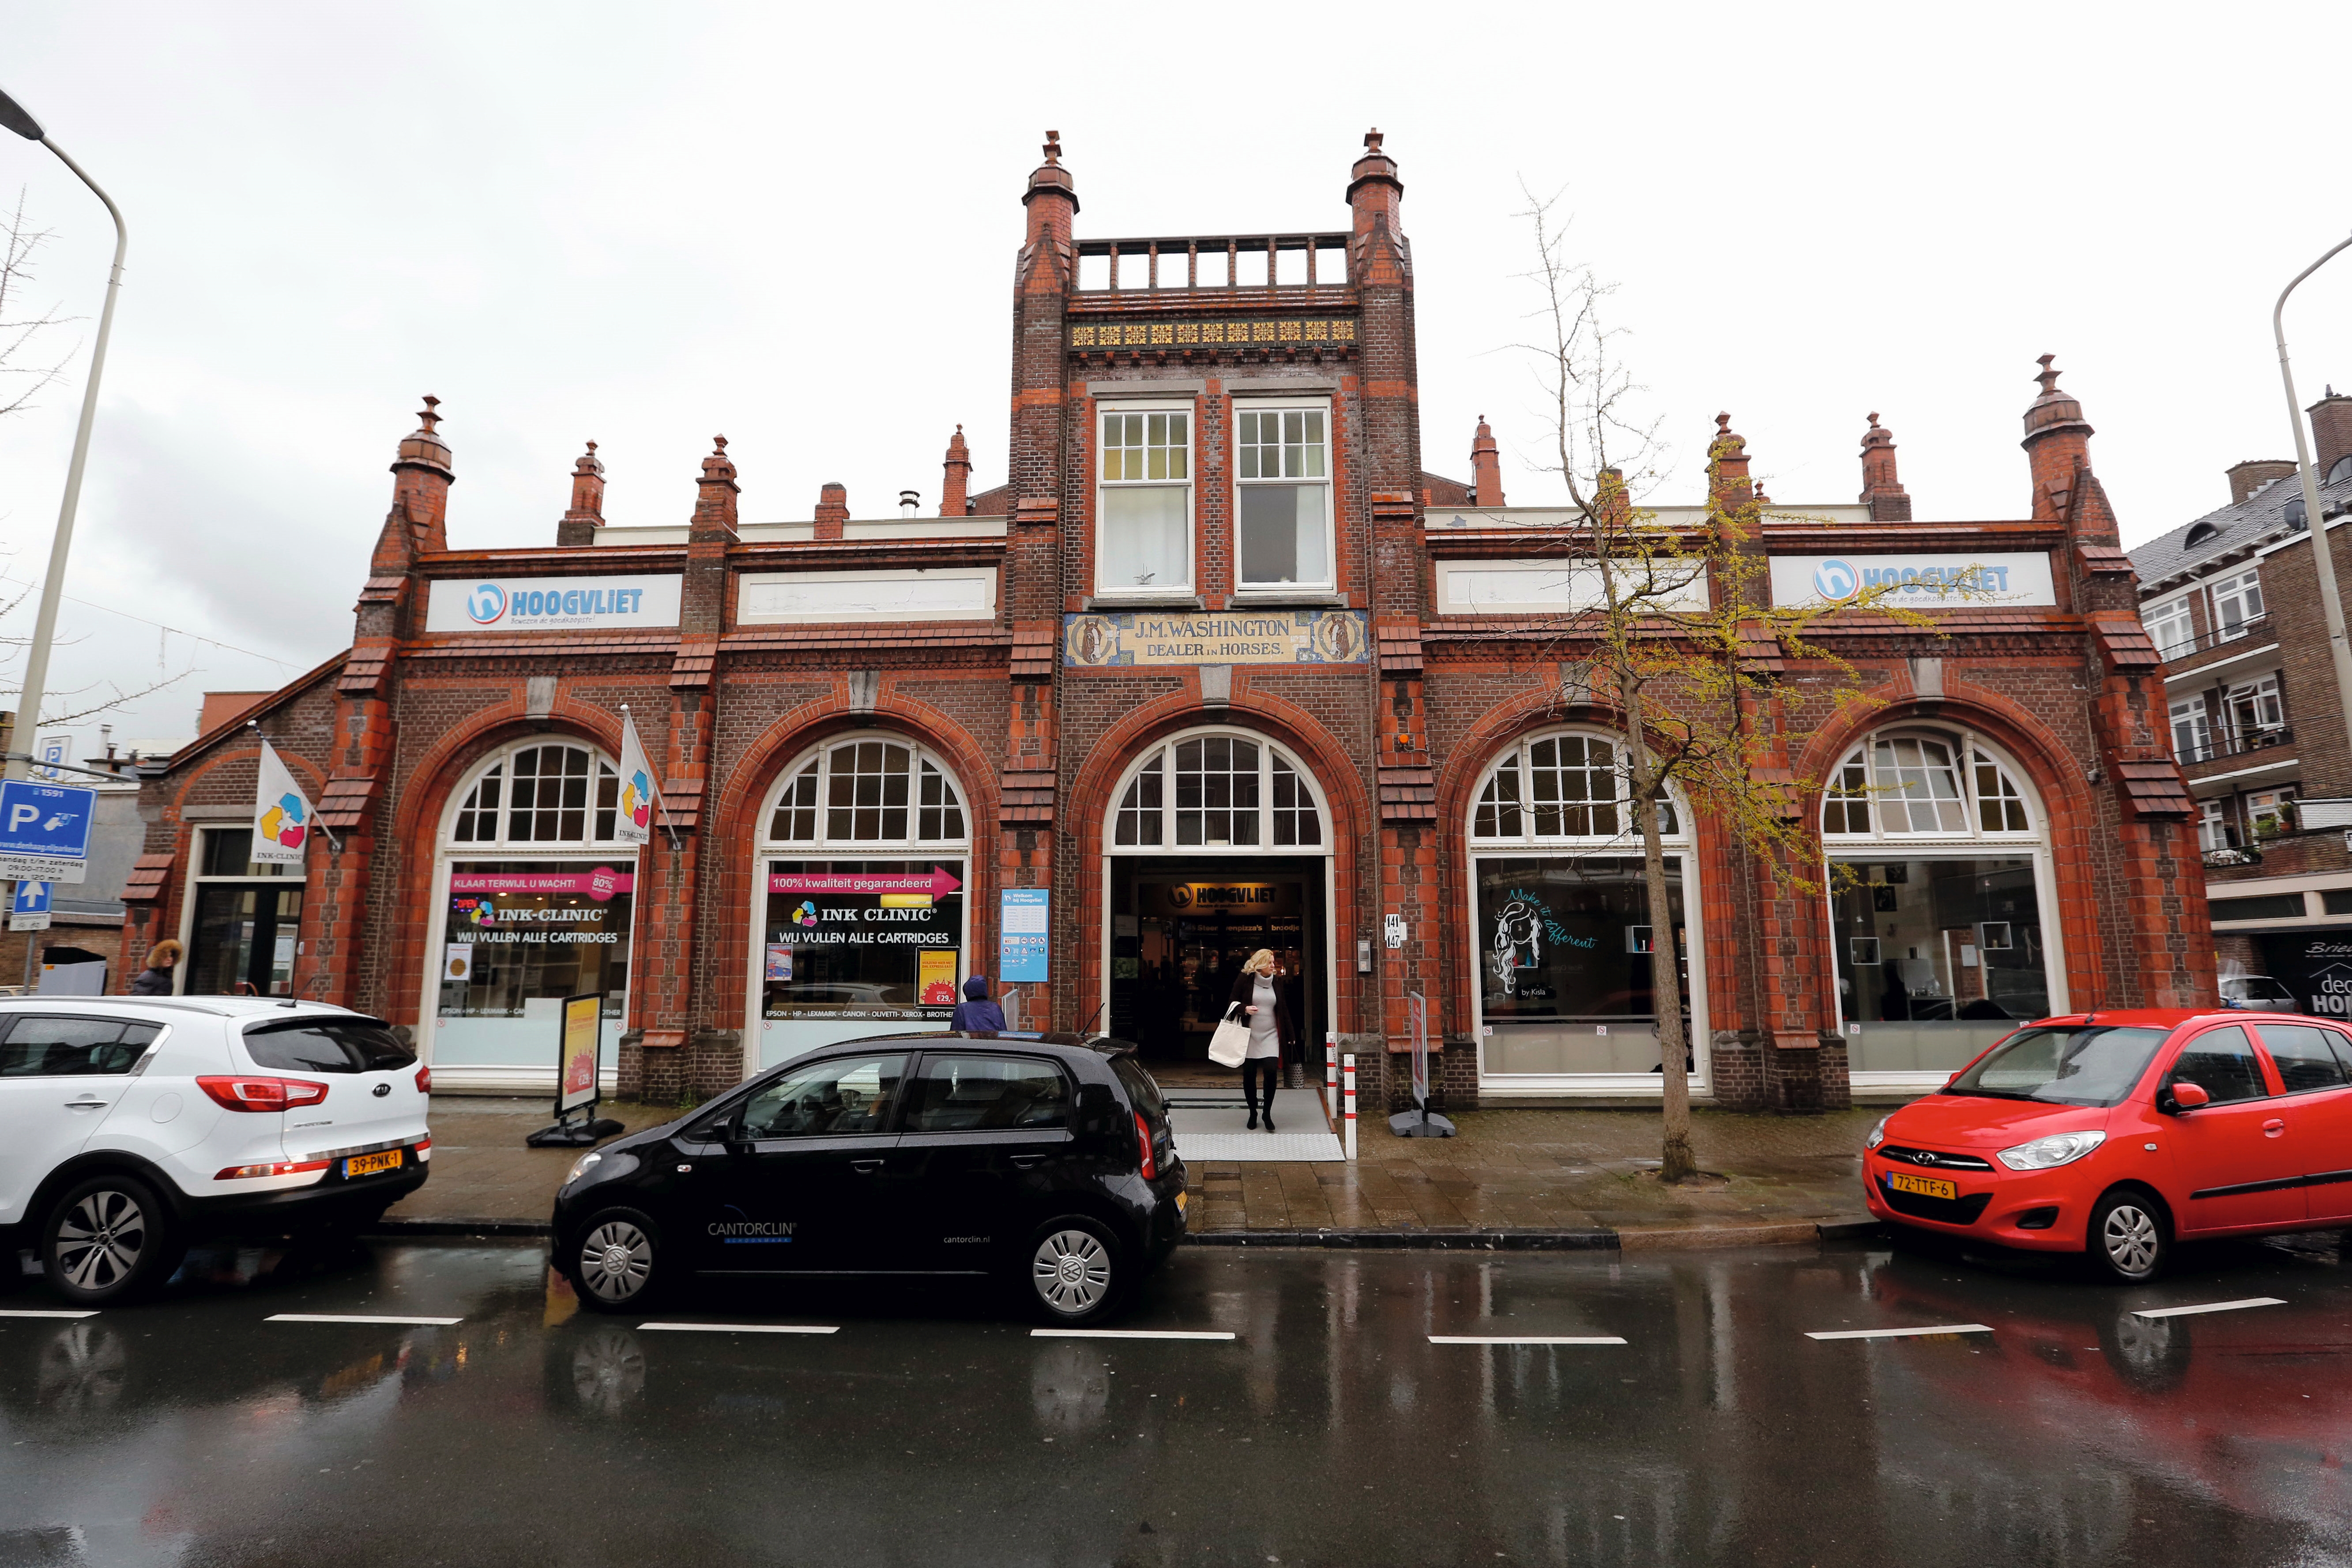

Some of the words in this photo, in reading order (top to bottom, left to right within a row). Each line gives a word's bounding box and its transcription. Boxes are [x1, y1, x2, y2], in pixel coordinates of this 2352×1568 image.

[511, 589, 643, 616] HOOGVLIET
[549, 615, 596, 625] goedkoopste!
[1147, 644, 1204, 656] DEALER
[1220, 643, 1284, 655] HORSES.
[41, 789, 64, 797] 1591
[8, 804, 40, 832] P
[8, 865, 56, 873] 09.00-17.00
[454, 880, 485, 888] KLAAR
[487, 880, 528, 888] TERWIJL
[529, 880, 537, 888] U
[538, 880, 576, 888] WACHT!
[592, 877, 613, 890] 80%
[773, 878, 802, 888] 100%
[805, 878, 851, 888] kwaliteit
[854, 878, 932, 890] gegarandeerd
[1197, 887, 1277, 903] HOOGVLIET
[1504, 888, 1542, 906] Make
[821, 909, 858, 921] INK
[1540, 906, 1552, 917] it
[1387, 915, 1399, 927] 141
[457, 932, 477, 943] WIJ
[478, 932, 519, 943] VULLEN
[522, 932, 547, 943] ALLE
[549, 932, 618, 944] CARTRIDGES
[779, 933, 799, 944] WIJ
[802, 933, 846, 944] VULLEN
[848, 933, 874, 944] ALLE
[877, 933, 949, 944] CARTRIDGES
[1544, 920, 1599, 948] different
[1387, 935, 1400, 947] 147
[353, 1153, 397, 1173] 39-PNK-1
[1897, 1176, 1949, 1196] 72-TTF-6
